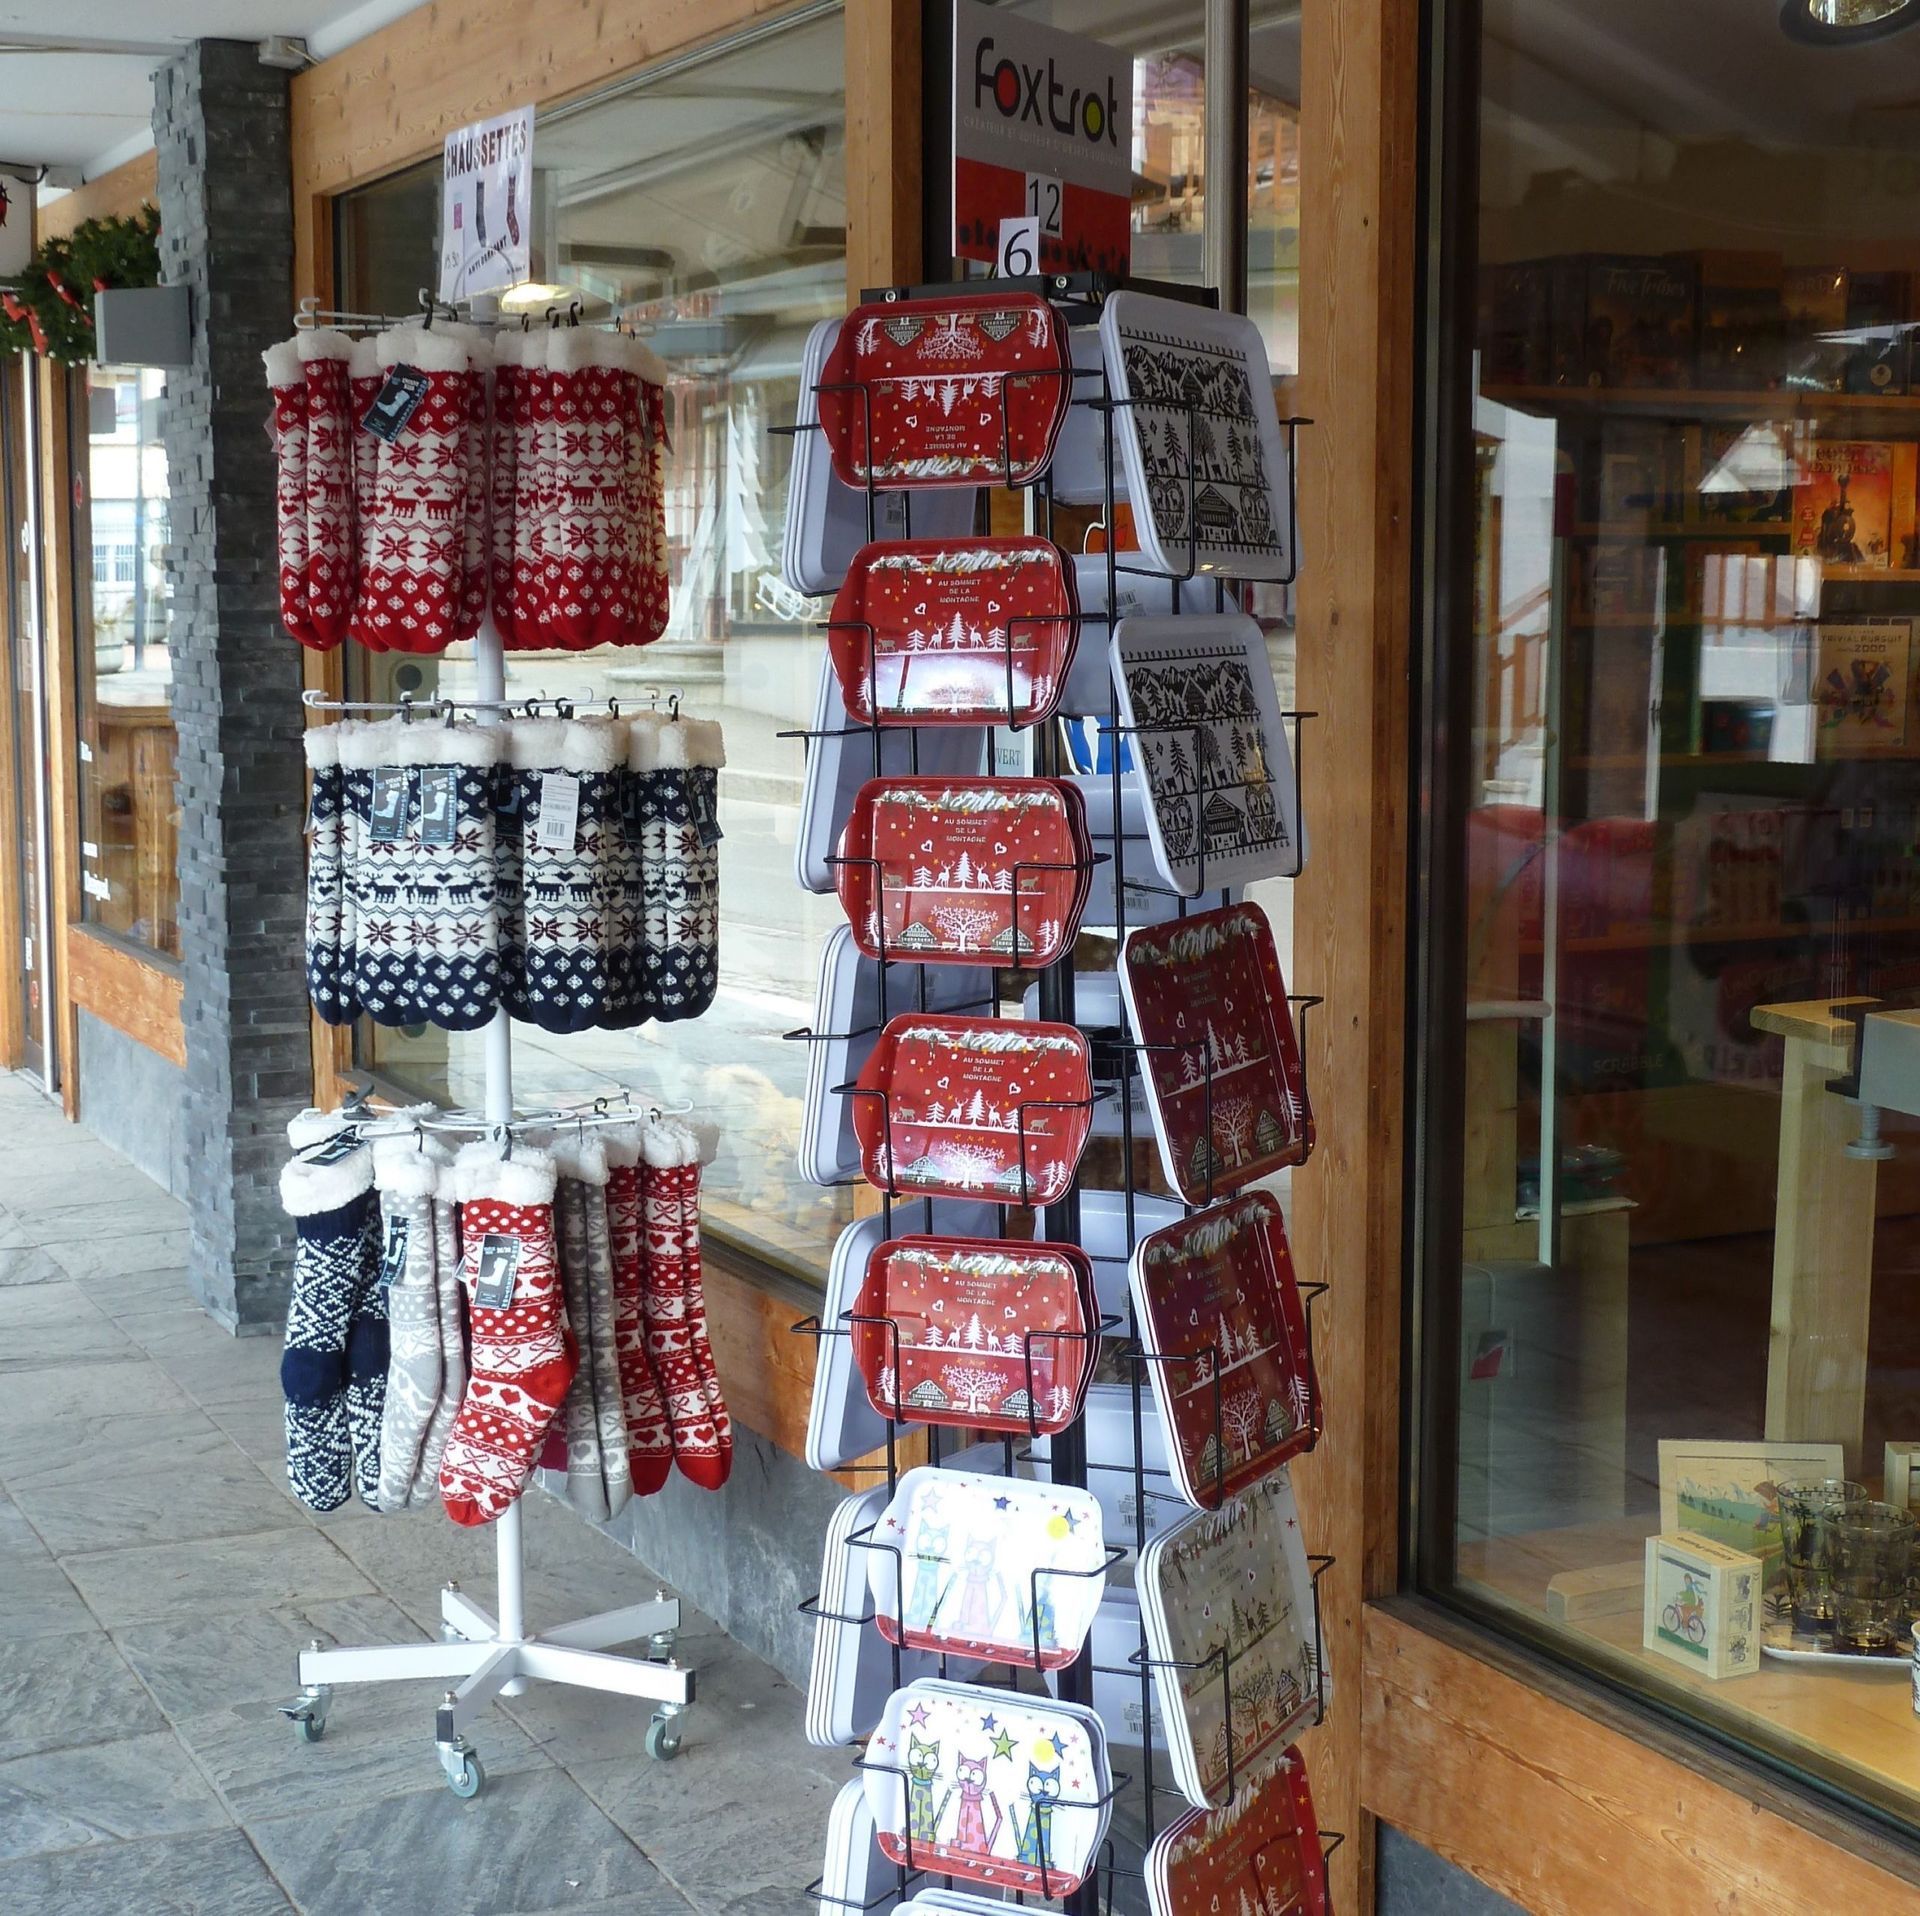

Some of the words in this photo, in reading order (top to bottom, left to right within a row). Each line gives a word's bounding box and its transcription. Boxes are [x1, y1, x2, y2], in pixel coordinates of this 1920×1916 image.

[975, 37, 1117, 147] foxtrot
[446, 120, 526, 180] CHAUSSETTES
[1028, 178, 1061, 232] 12
[1003, 228, 1033, 278] 6
[1855, 643, 1886, 653] 2000
[962, 1073, 1002, 1083] MONTAGNE
[1593, 1053, 1664, 1074] SCRABBLE
